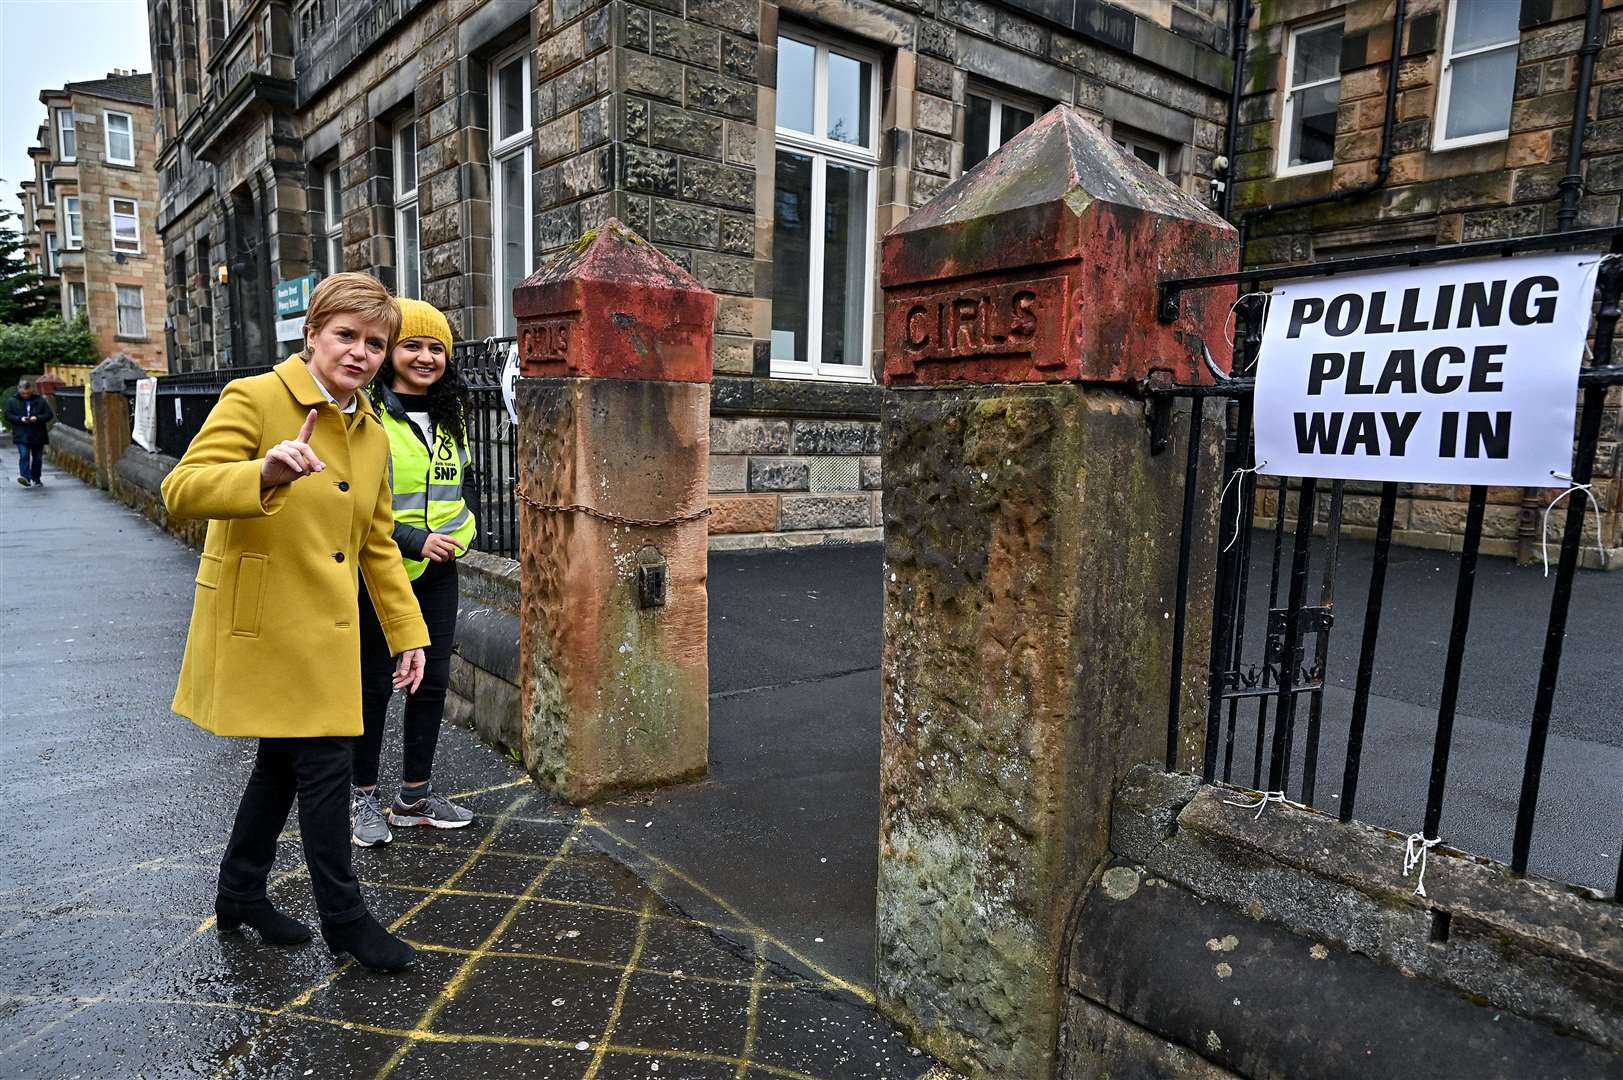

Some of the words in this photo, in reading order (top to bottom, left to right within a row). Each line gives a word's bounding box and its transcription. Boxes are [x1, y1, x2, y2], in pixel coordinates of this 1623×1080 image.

[1286, 275, 1559, 339] POLLING
[1307, 344, 1508, 396] PLACE
[1293, 411, 1422, 457] WAY
[1438, 411, 1512, 459] IN
[434, 466, 457, 480] SNP
